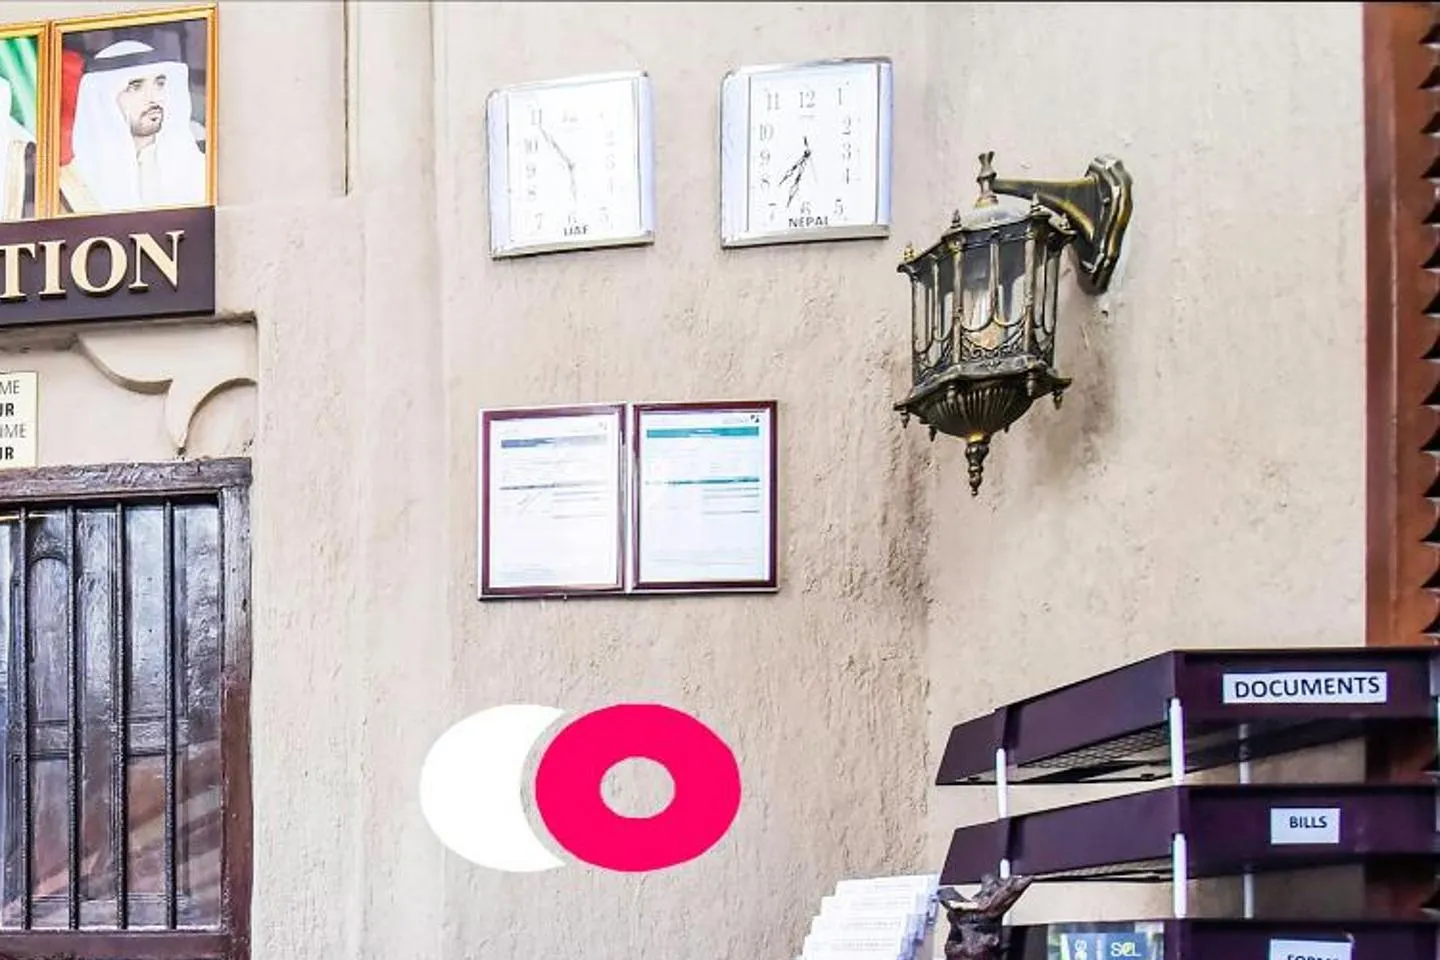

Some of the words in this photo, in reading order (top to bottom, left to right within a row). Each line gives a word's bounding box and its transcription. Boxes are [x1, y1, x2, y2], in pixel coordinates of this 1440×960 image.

[799, 90, 816, 109] 12
[1234, 676, 1380, 699] DOCUMENTS
[1288, 815, 1327, 830] BILLS
